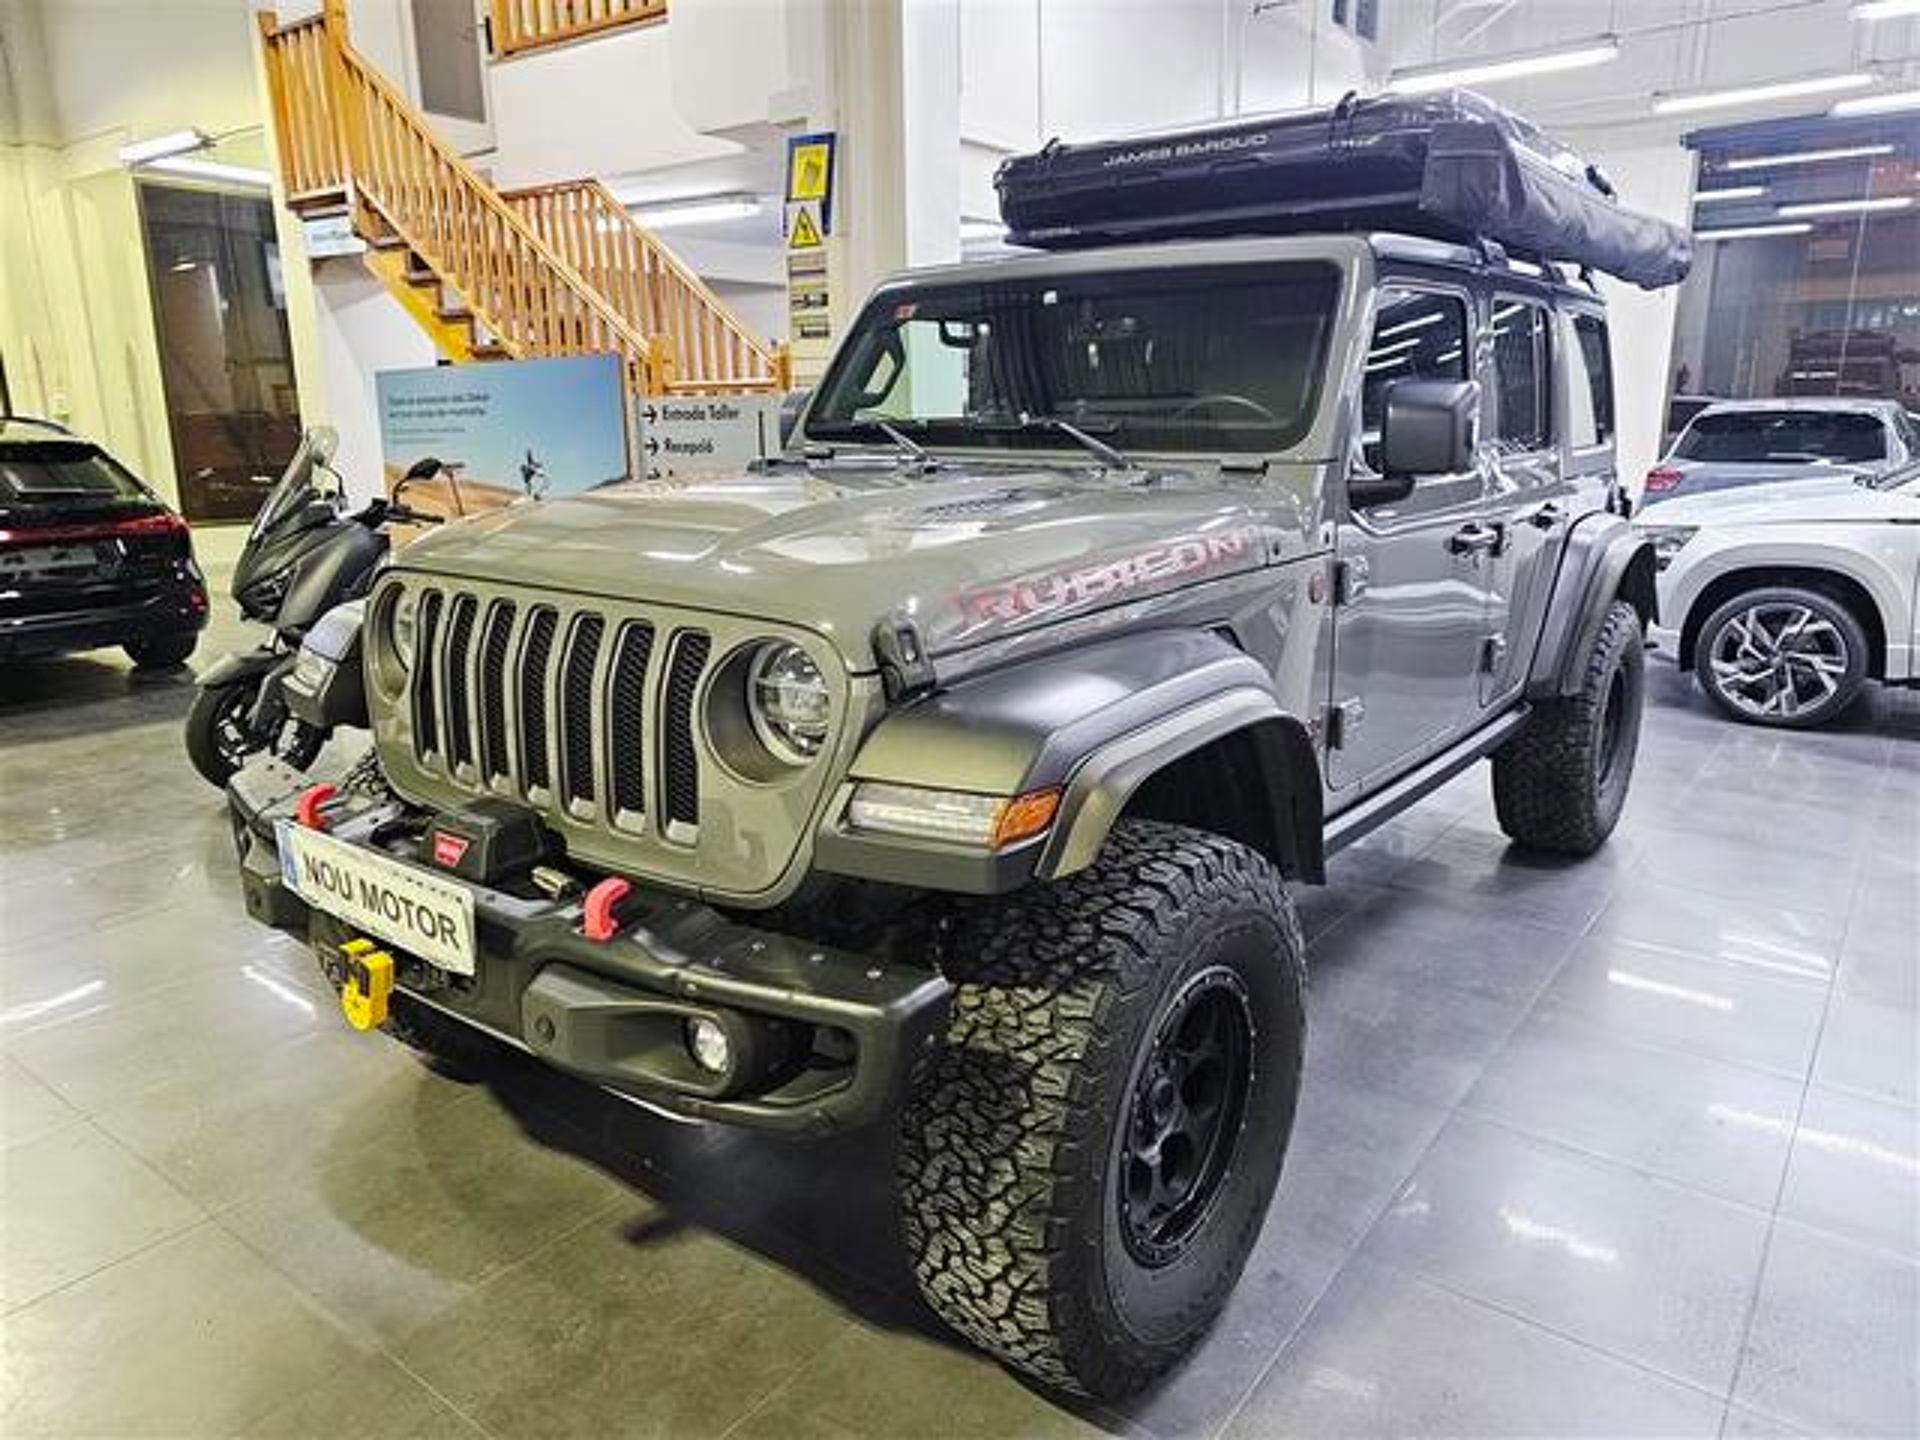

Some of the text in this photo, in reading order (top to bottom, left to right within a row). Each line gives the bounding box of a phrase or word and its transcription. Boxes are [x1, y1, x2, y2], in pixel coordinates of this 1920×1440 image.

[1103, 134, 1267, 167] JAMES BAROUD
[663, 404, 739, 420] Entrada Taller
[950, 533, 1249, 626] RUBICON
[303, 853, 351, 900] NOU
[360, 880, 460, 949] MOTOR
